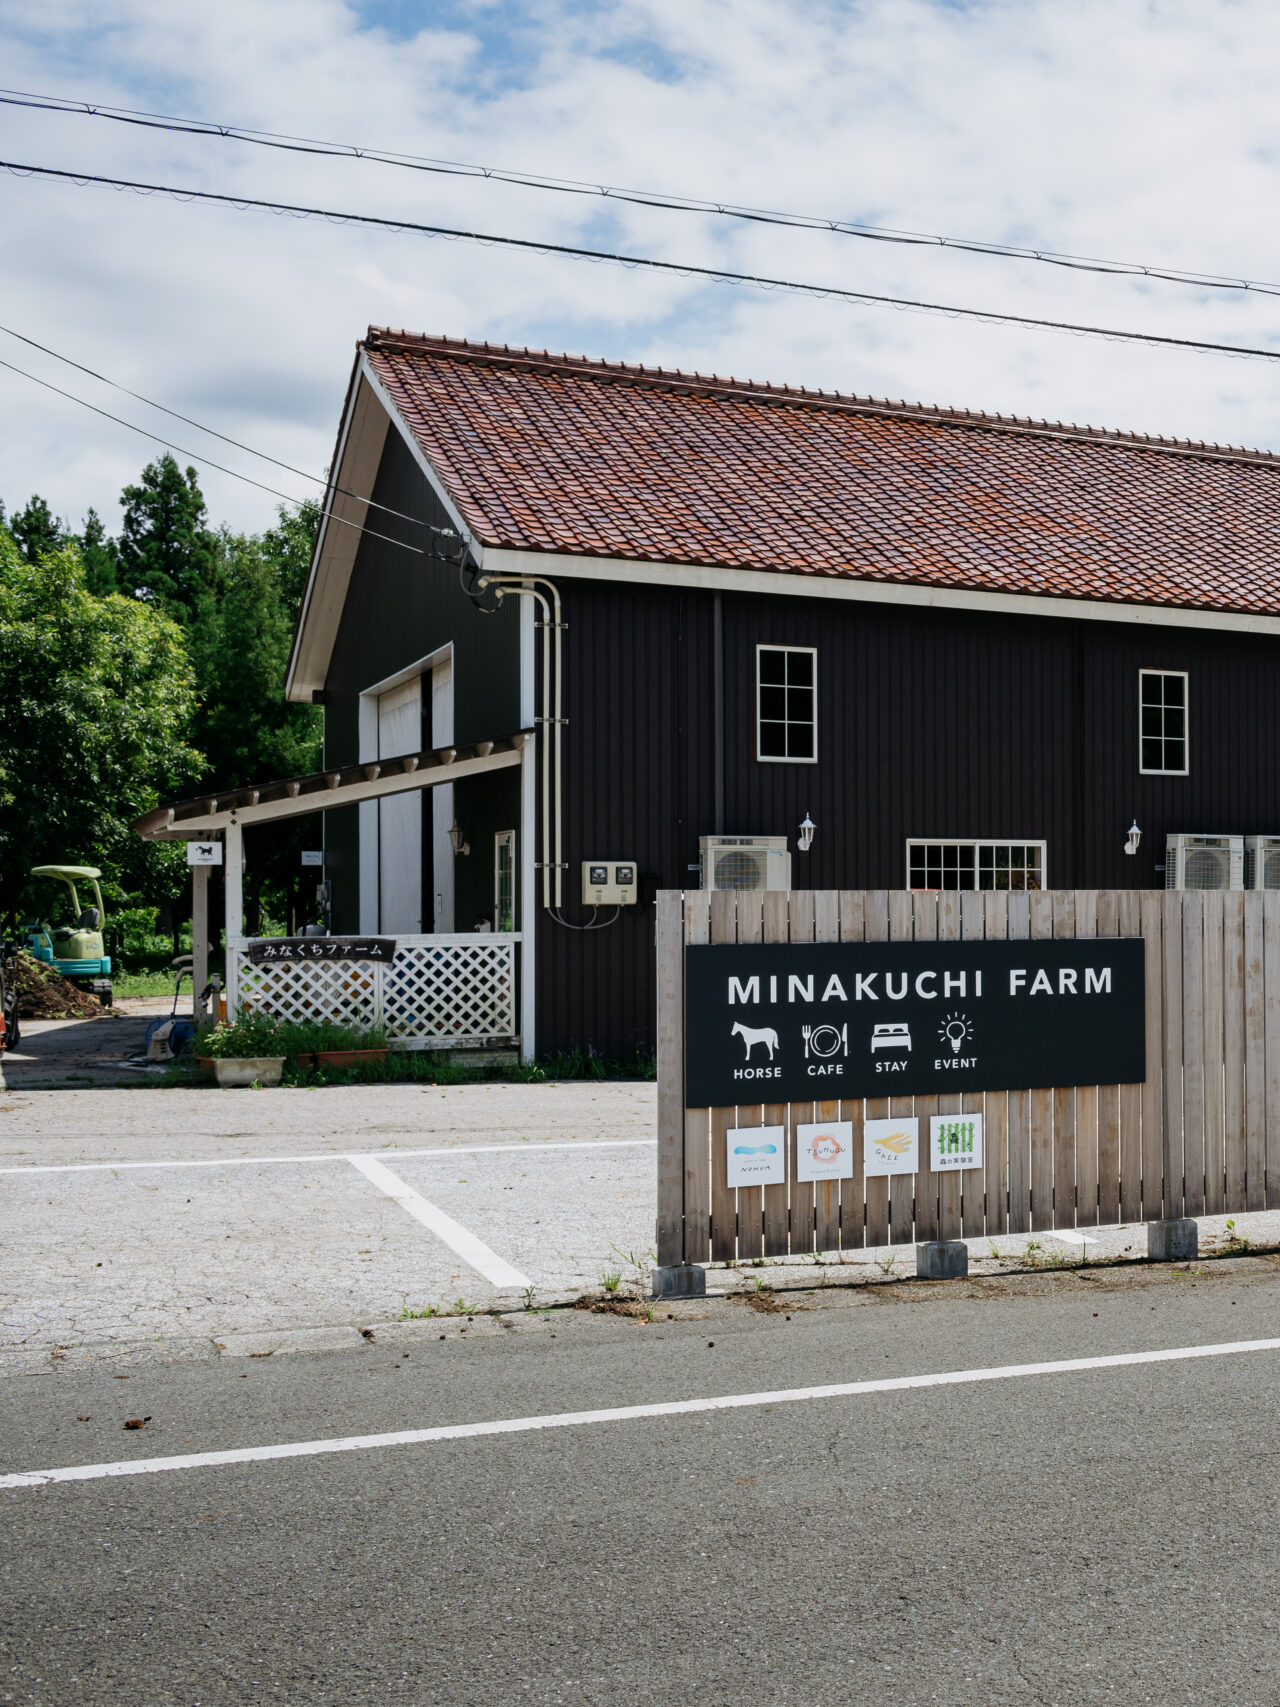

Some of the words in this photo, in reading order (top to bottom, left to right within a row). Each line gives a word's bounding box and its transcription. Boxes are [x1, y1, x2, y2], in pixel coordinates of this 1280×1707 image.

[263, 943, 383, 957] みなくちファーム
[728, 970, 982, 1005] MINAKUCHI
[1009, 967, 1112, 996] FARM
[807, 1064, 844, 1076] CAFE
[875, 1060, 908, 1073] STAY
[934, 1057, 977, 1070] EVENT
[733, 1066, 782, 1080] HORSE
[807, 1147, 846, 1157] TSUMUGU
